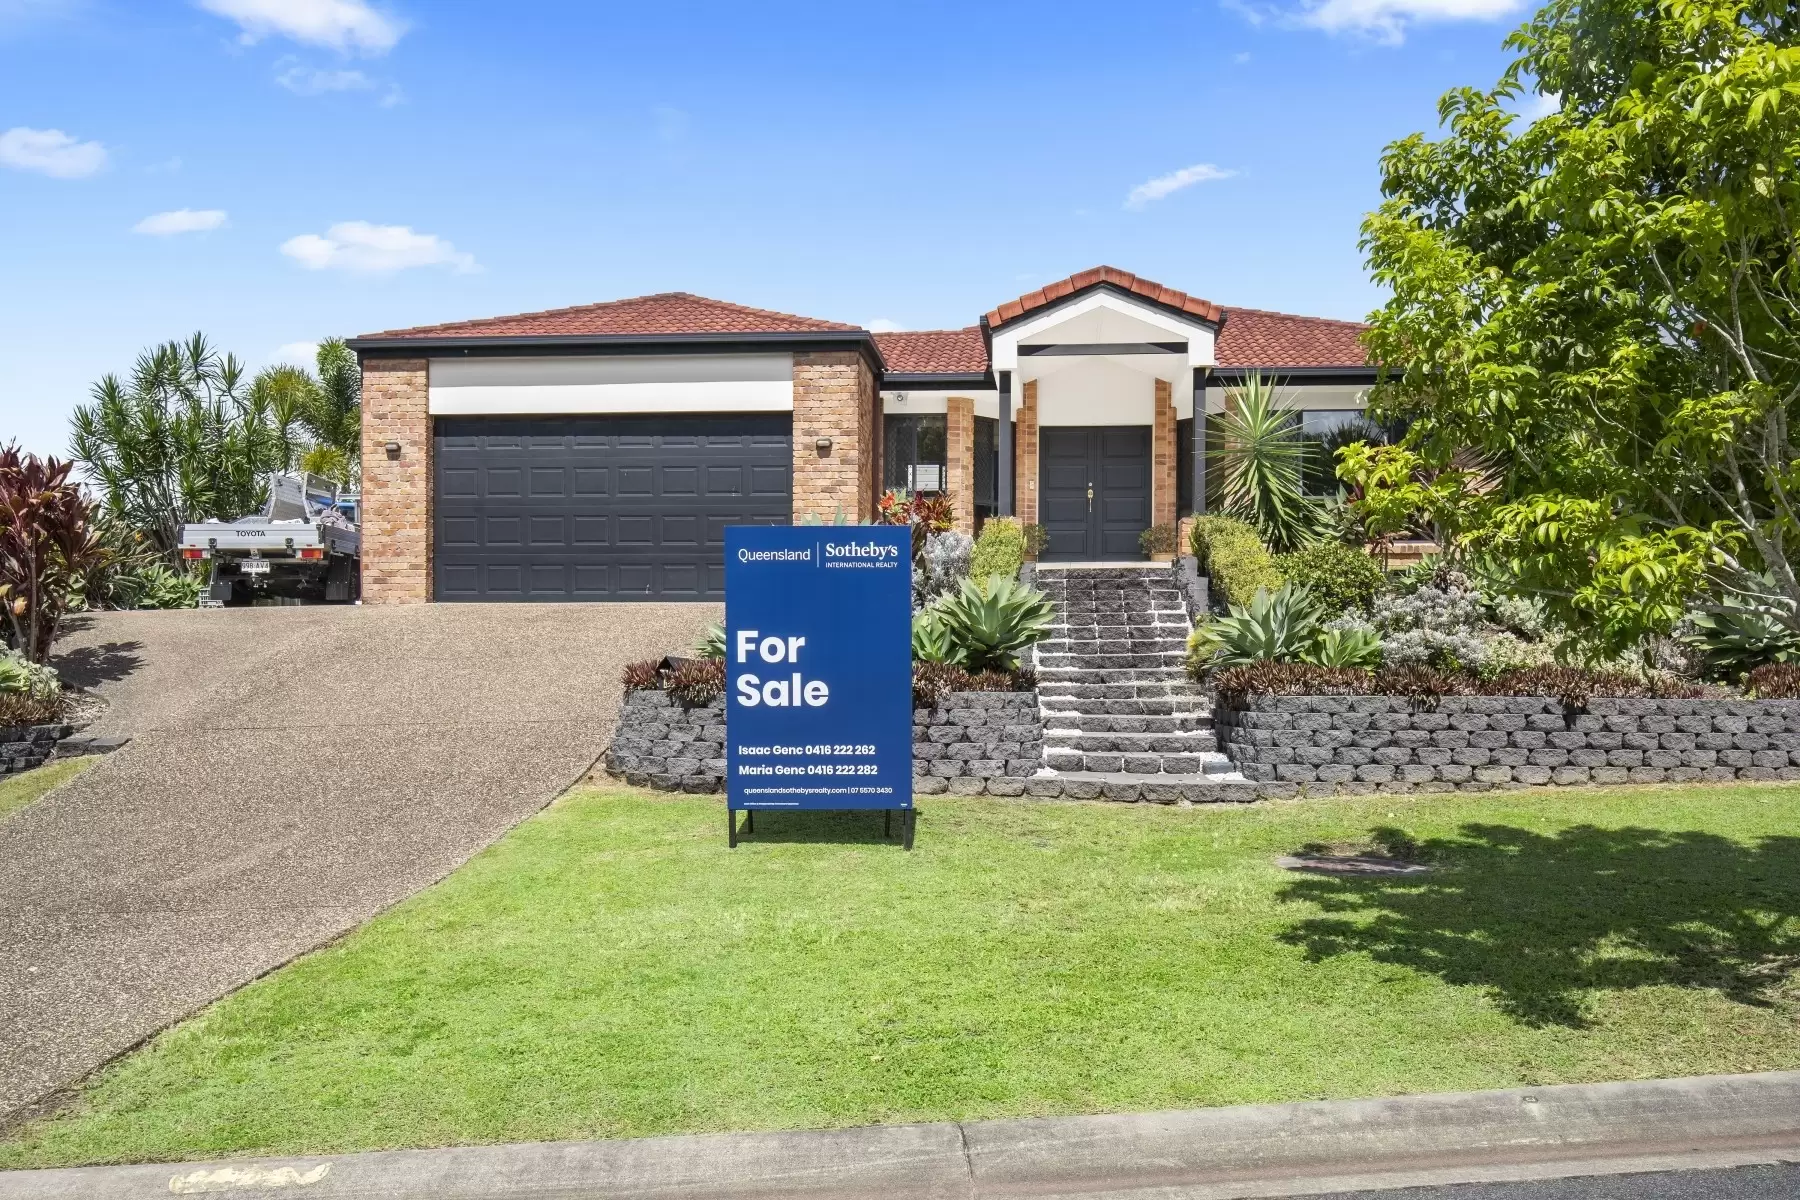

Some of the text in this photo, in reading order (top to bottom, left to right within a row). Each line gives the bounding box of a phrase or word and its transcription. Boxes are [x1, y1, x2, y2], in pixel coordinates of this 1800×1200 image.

[738, 548, 811, 563] Queensland
[825, 541, 898, 560] Sotheby's
[736, 630, 806, 664] For
[736, 672, 829, 707] Sale
[738, 745, 876, 755] Isaac Genc 0416 222 262
[738, 764, 878, 775] Maria Genc 0416 222 282
[743, 786, 848, 795] queenslandsothebysrealty.com
